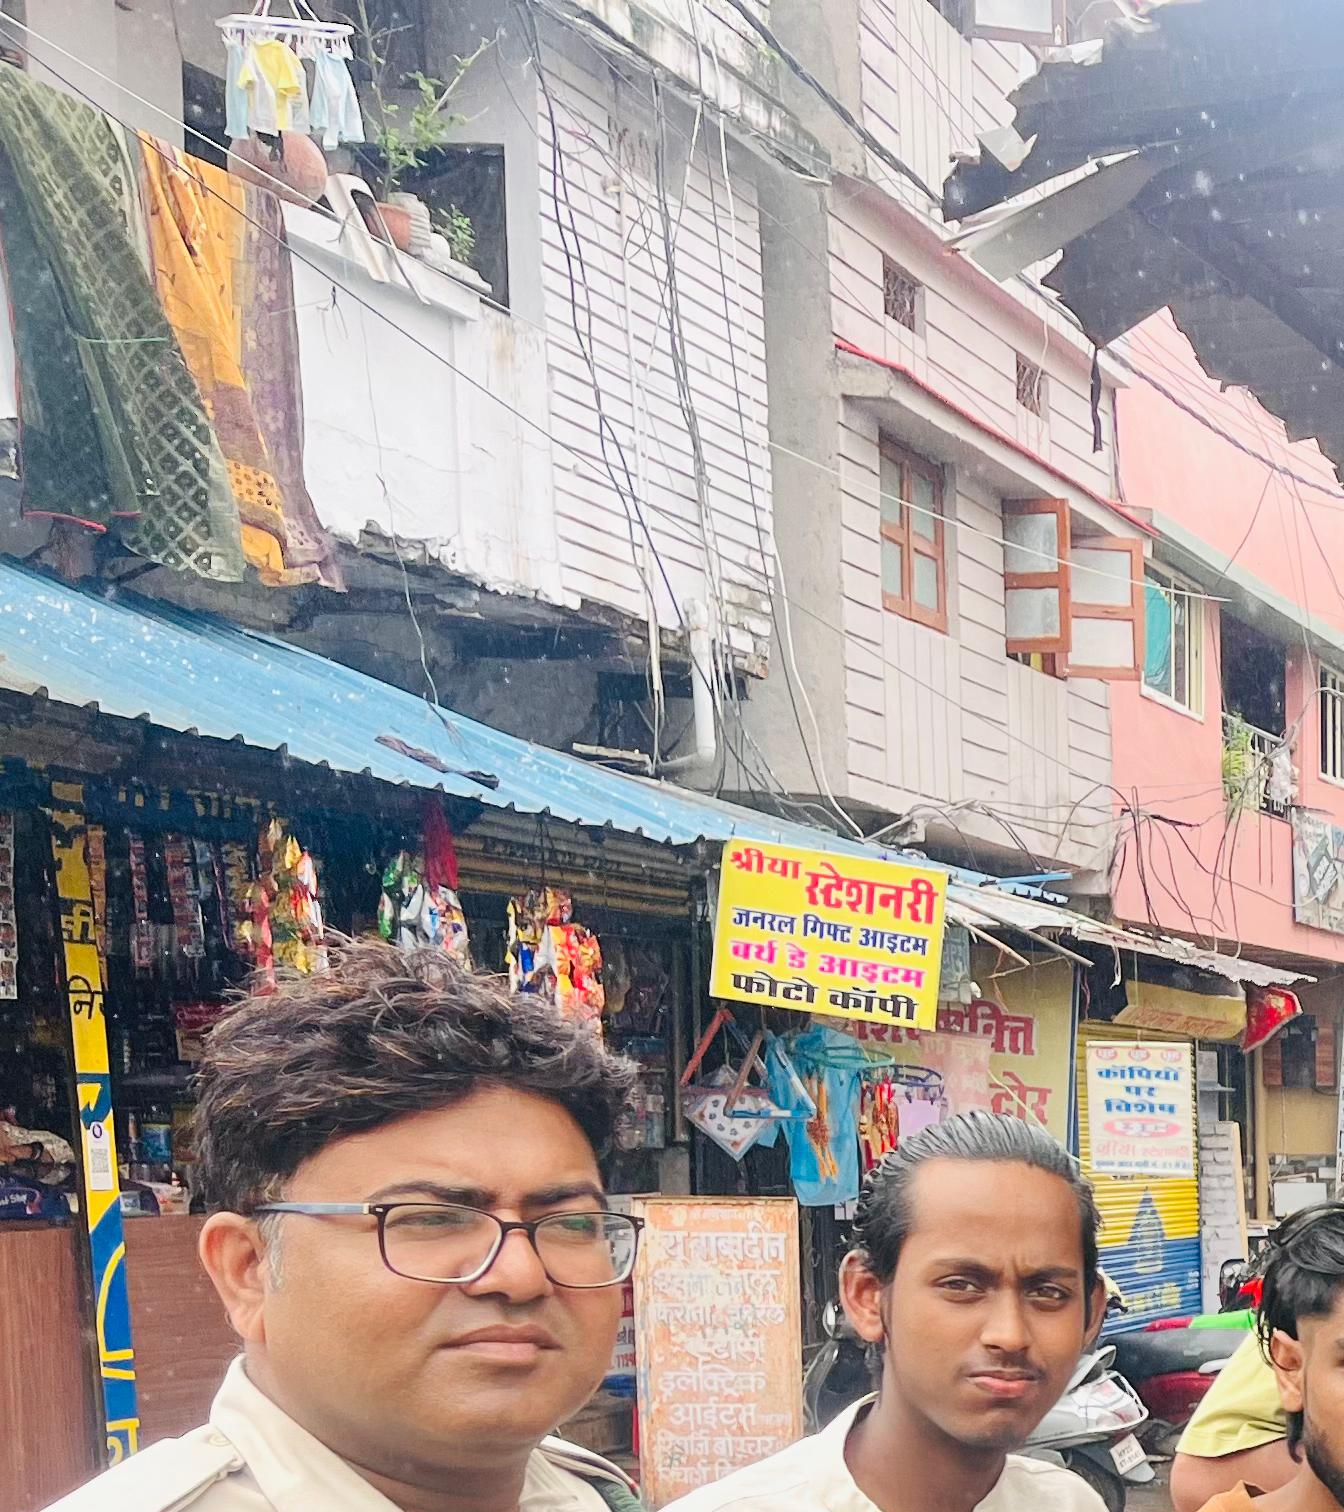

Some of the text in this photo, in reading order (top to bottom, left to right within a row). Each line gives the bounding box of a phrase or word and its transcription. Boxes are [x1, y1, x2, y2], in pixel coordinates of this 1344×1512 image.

[805, 862, 938, 925] स्टेशनरी
[732, 907, 929, 955] जनरल गिफ्ट आइटम
[786, 942, 808, 969] डे
[818, 953, 926, 988] आइटम
[731, 970, 919, 1021] फोटो कॉपी
